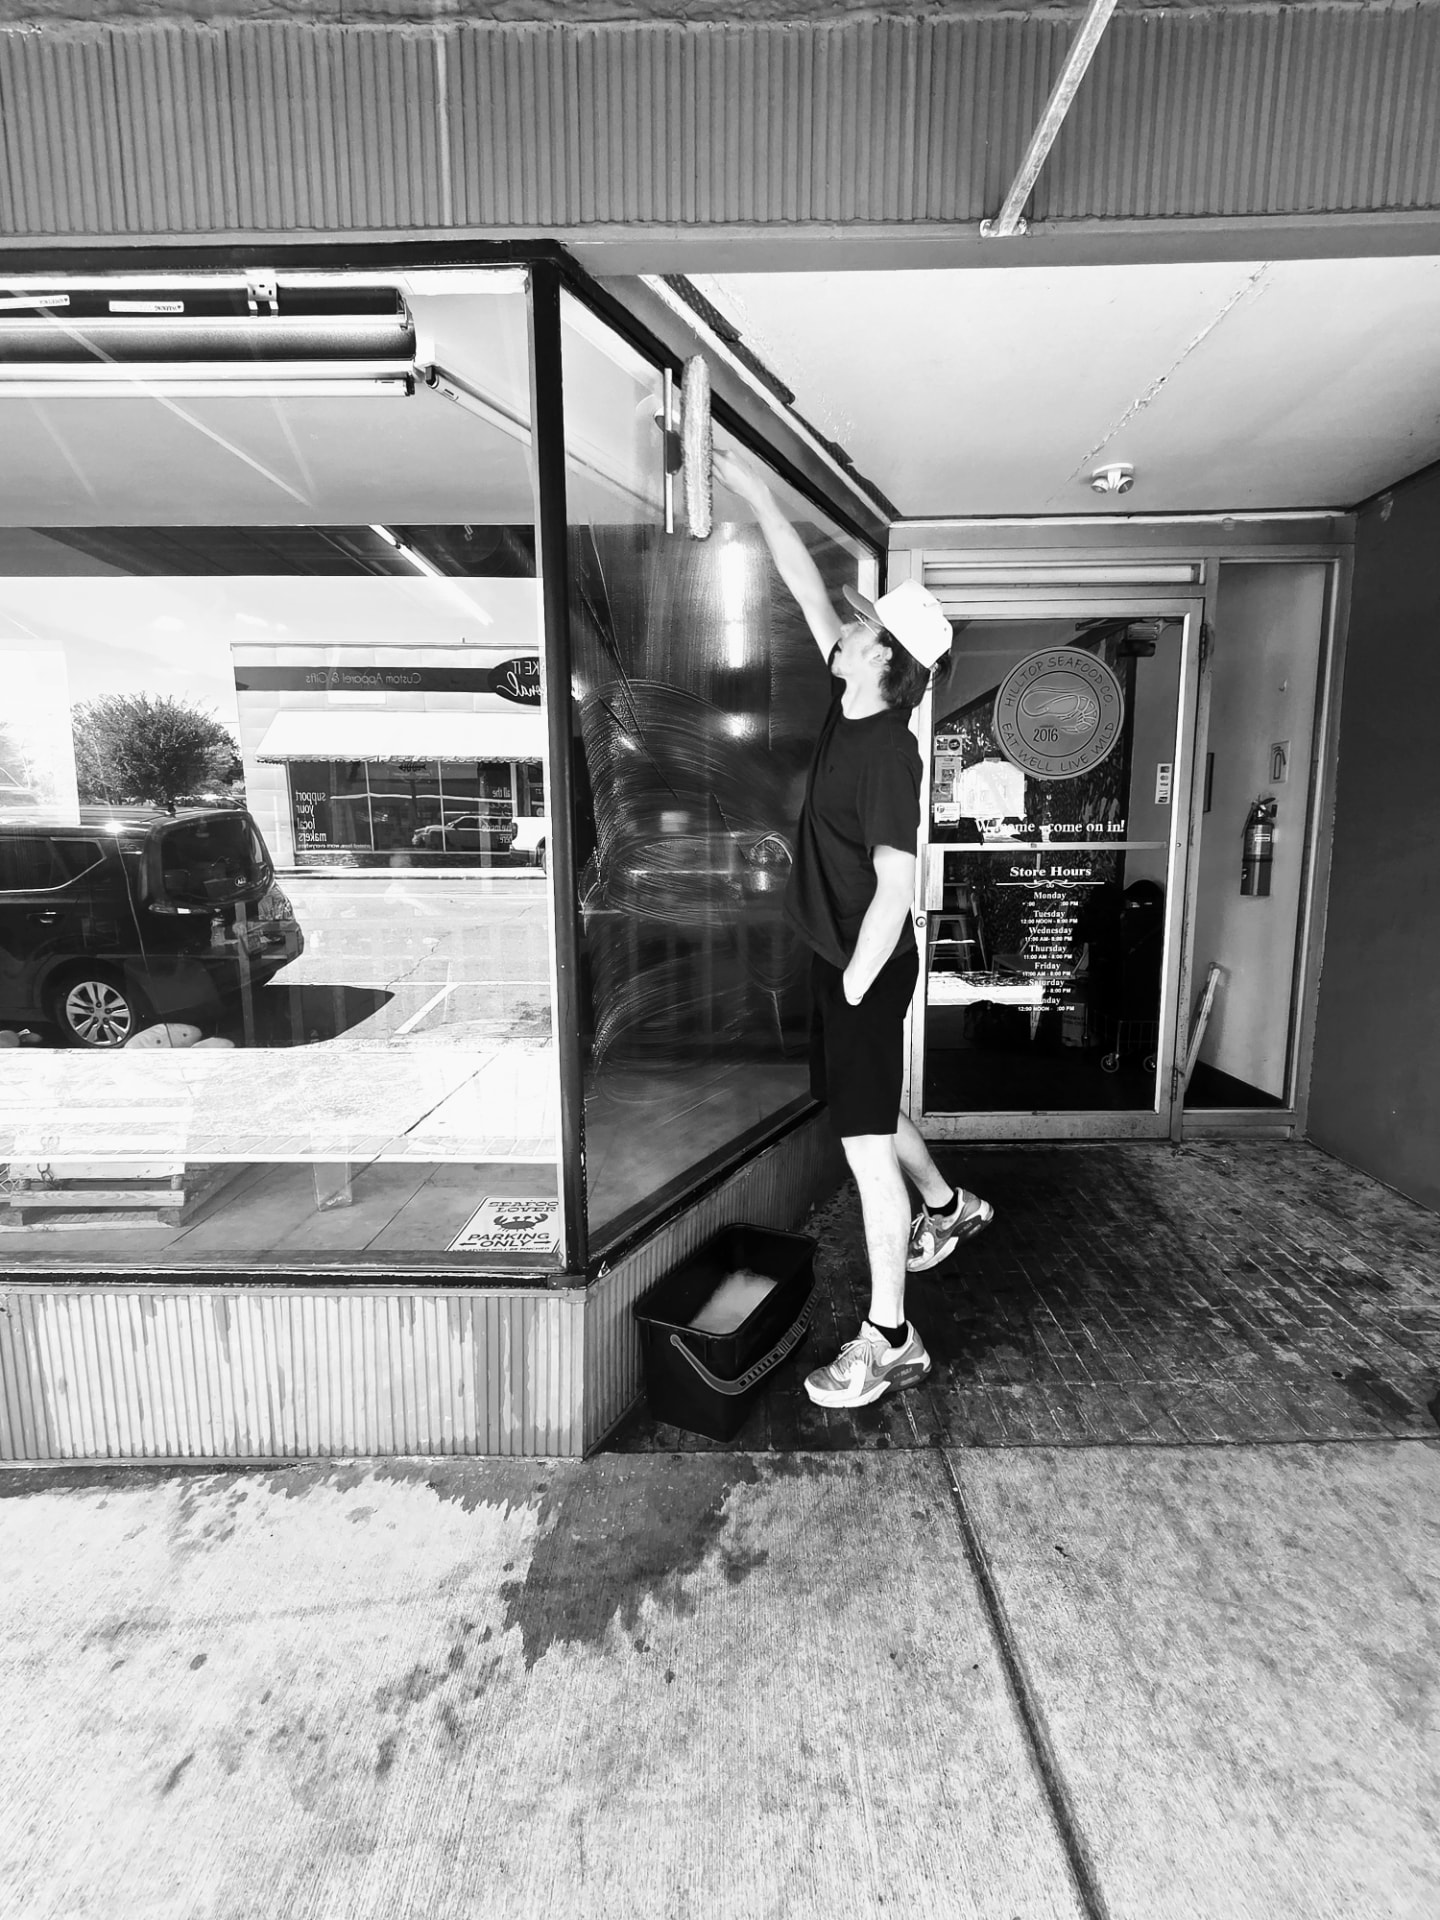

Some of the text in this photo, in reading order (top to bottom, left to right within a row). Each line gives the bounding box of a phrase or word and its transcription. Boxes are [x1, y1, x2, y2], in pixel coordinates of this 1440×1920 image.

[1004, 656, 1114, 707] HILLTOP SEAFOOD CO.
[1033, 728, 1058, 742] 2016
[1002, 722, 1114, 772] EAT WELL LIVE WILD
[1086, 823, 1104, 832] on
[1107, 820, 1125, 832] in!
[1010, 866, 1092, 877] Store Hours
[1034, 891, 1067, 900] Monday
[1033, 910, 1066, 919] Tuesday
[1029, 926, 1073, 936] Wednesday
[1028, 944, 1067, 954] Thursday
[1034, 962, 1060, 970] Friday
[468, 1232, 550, 1241] PARKING
[480, 1240, 532, 1248] ONLY
